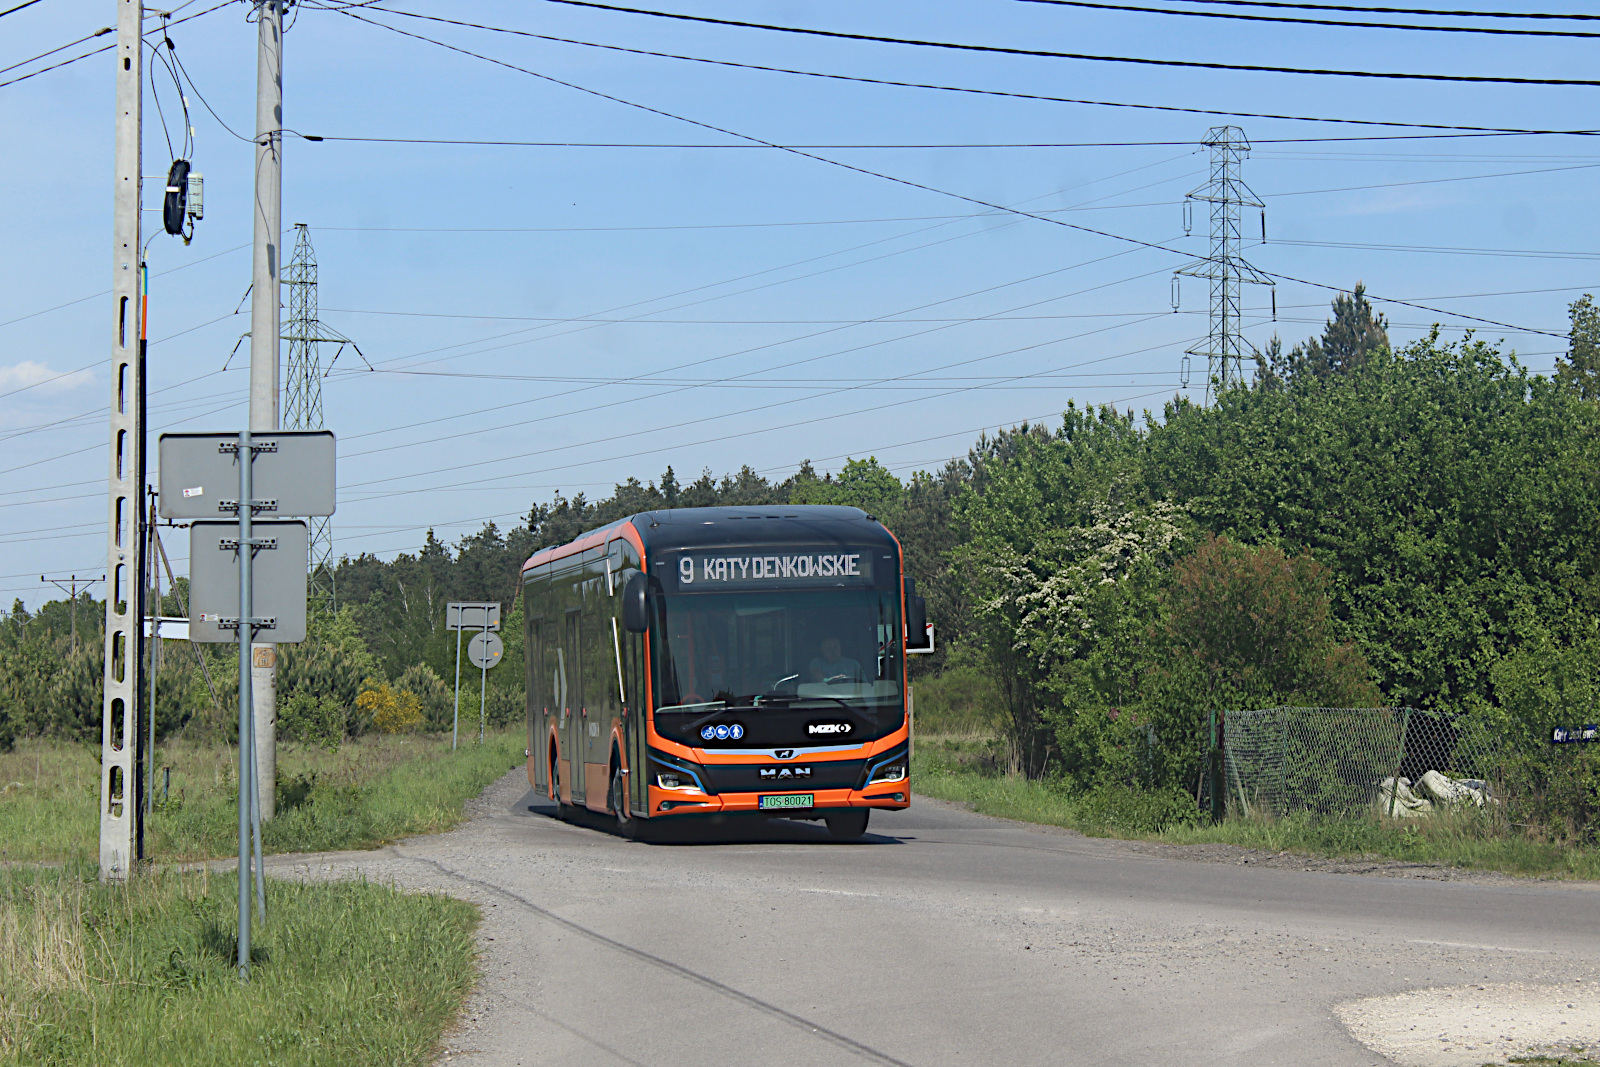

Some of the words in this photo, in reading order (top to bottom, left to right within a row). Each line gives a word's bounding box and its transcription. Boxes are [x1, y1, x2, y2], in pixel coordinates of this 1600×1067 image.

[680, 556, 694, 584] 9
[752, 554, 861, 578] DENKOWSKIE
[808, 724, 840, 734] MZK
[760, 767, 811, 780] MAN
[764, 796, 782, 807] TOS
[784, 794, 812, 806] 80021
